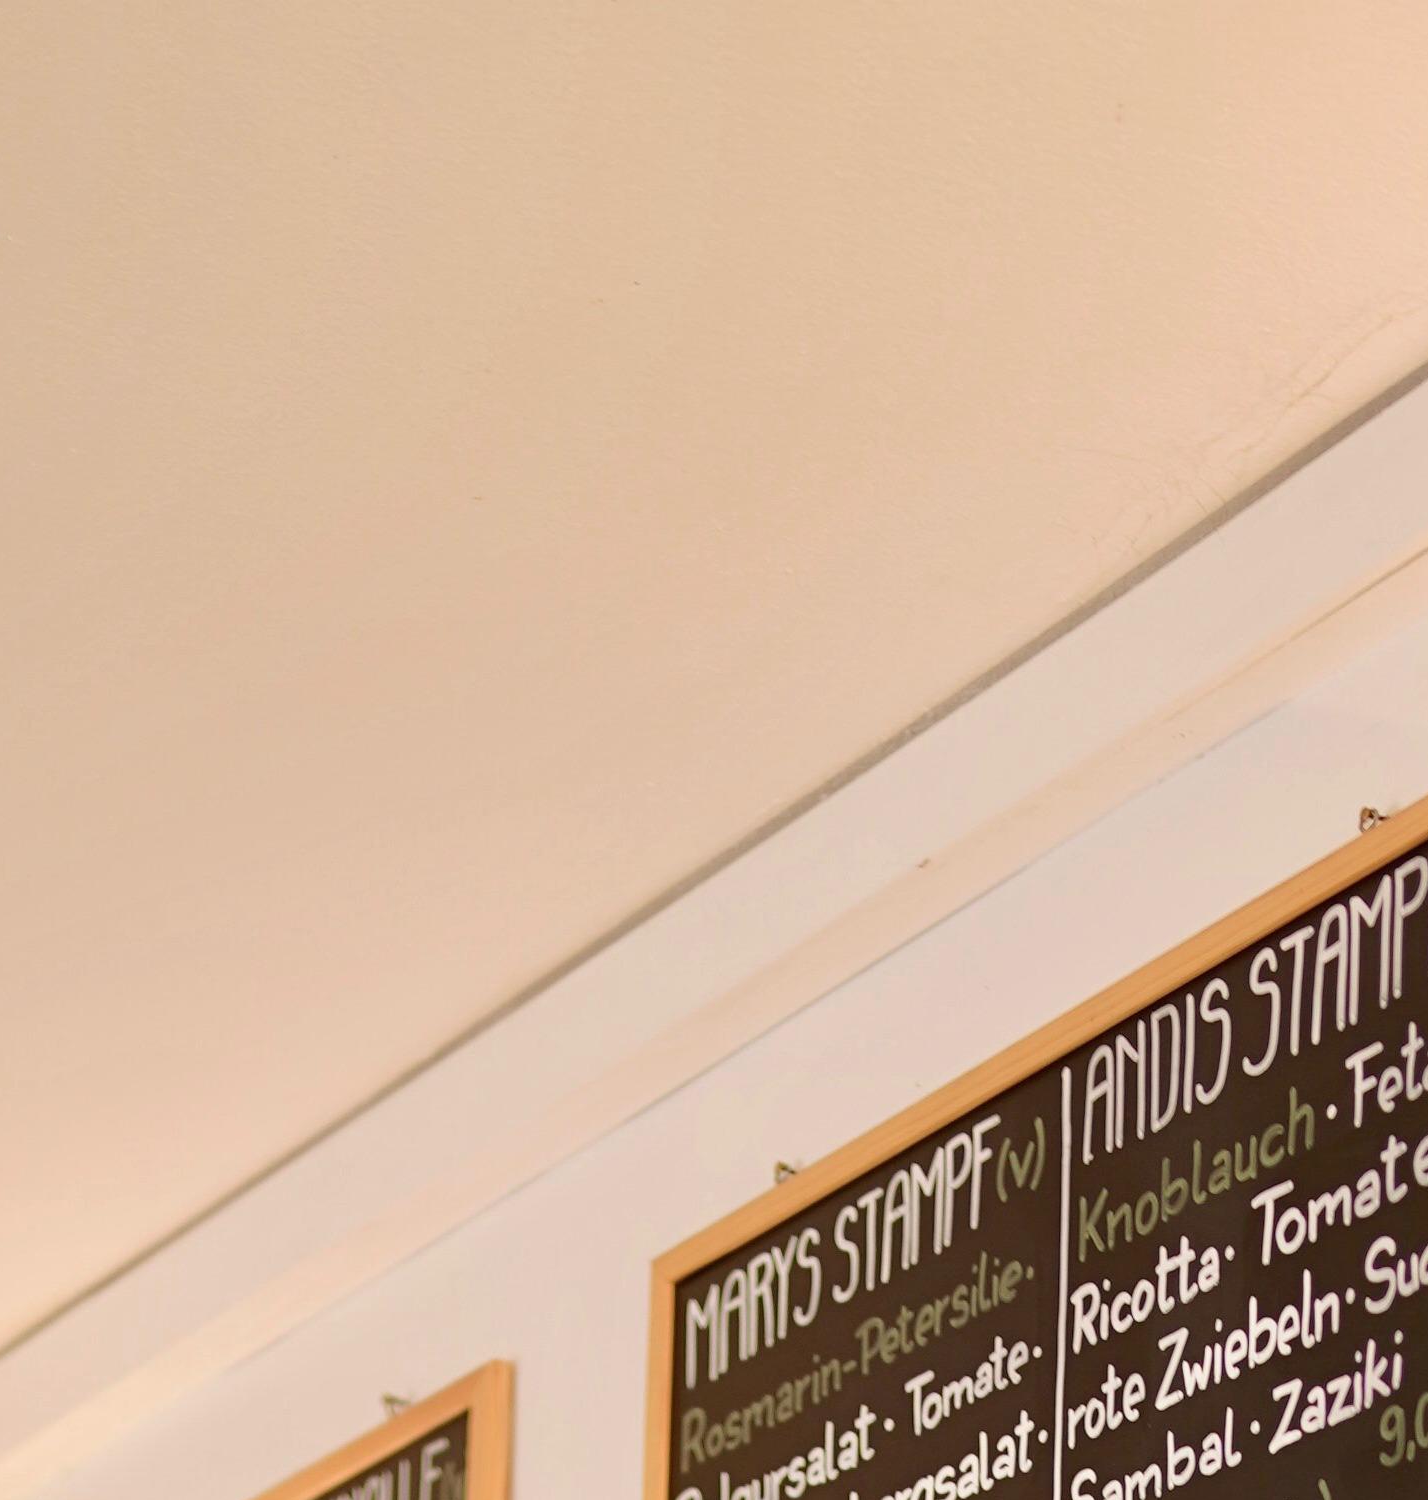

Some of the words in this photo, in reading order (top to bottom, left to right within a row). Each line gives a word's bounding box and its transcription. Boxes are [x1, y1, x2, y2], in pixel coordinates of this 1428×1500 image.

[1082, 977, 1232, 1166] ANDIS
[685, 1227, 822, 1390] MARYS
[832, 1113, 1002, 1304] STAMPF
[996, 1116, 1046, 1203] (v)
[1078, 1086, 1316, 1262] Knoblauch
[679, 1250, 1021, 1475] Rosmarin-Petersilie
[1068, 1364, 1146, 1450] rote
[1155, 1268, 1340, 1411] Zwiebeln
[1070, 1235, 1220, 1355] Ricotta
[905, 1335, 1029, 1437] Tomate
[1269, 1330, 1404, 1455] Zaziki
